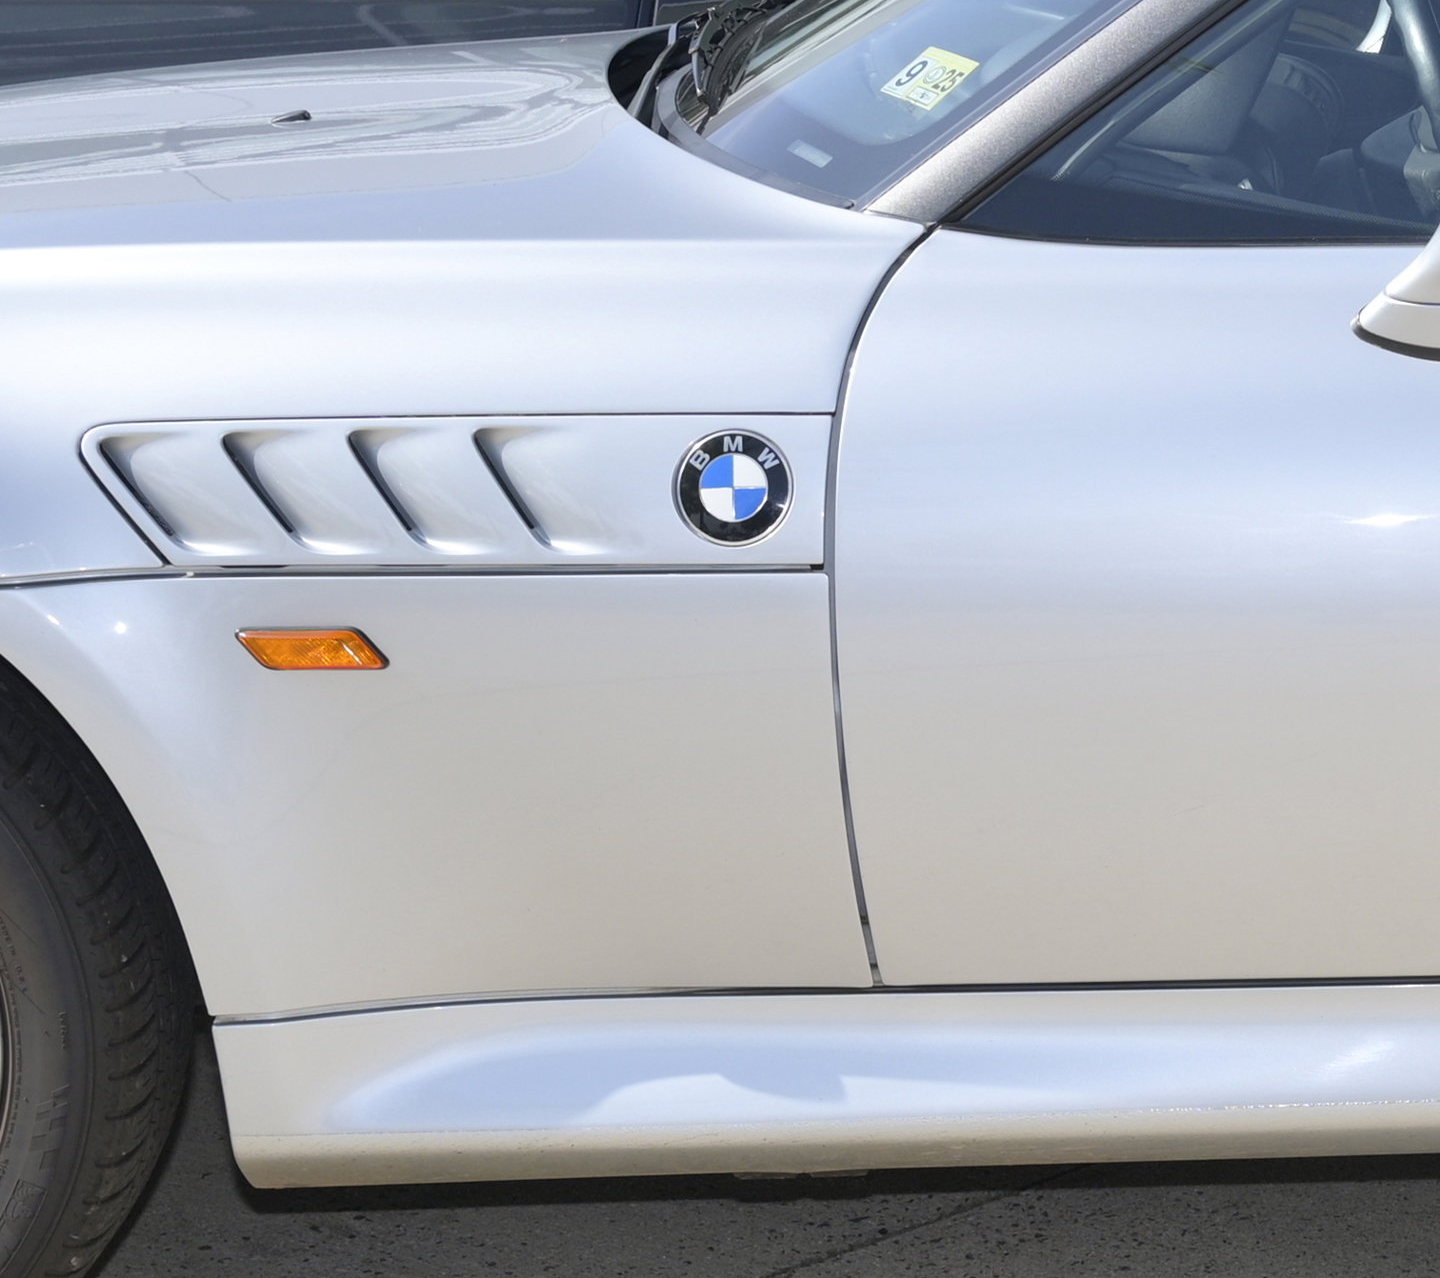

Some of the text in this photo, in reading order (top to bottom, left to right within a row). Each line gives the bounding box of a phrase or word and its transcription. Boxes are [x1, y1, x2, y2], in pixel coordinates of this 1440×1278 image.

[895, 60, 965, 93] 9 25
[689, 435, 780, 471] BMW
